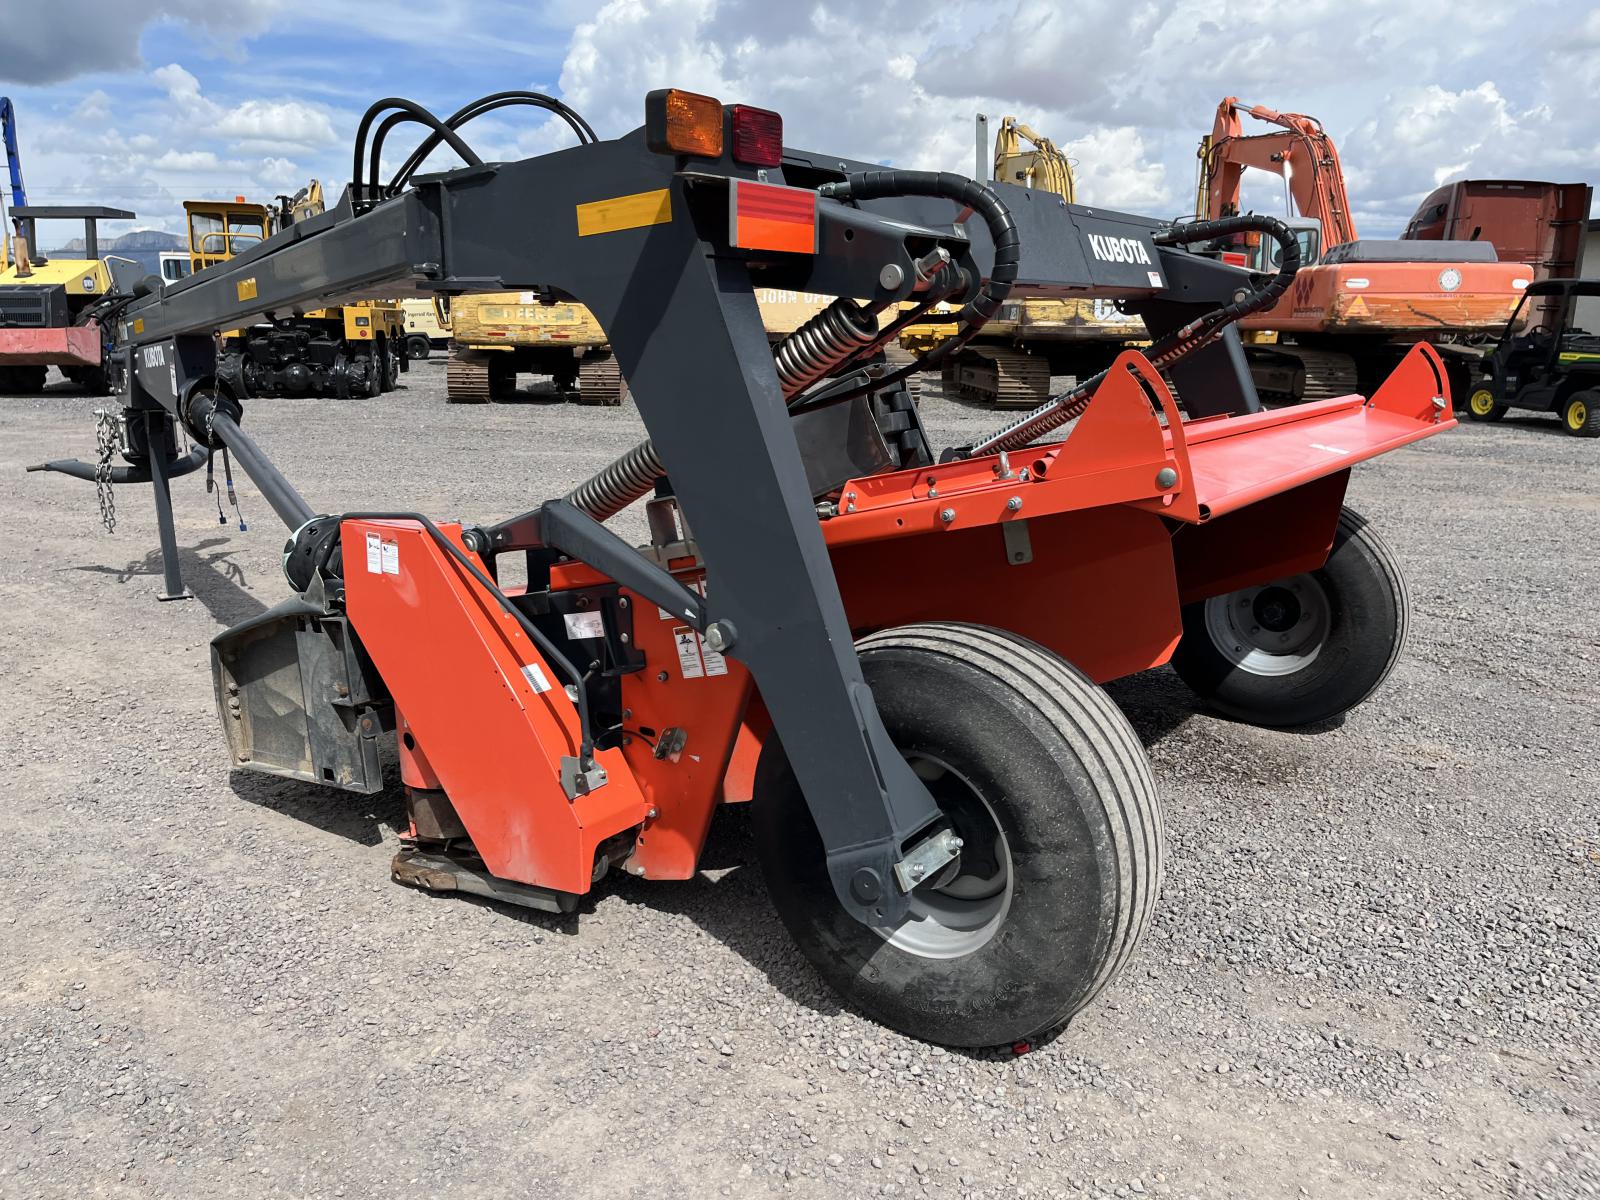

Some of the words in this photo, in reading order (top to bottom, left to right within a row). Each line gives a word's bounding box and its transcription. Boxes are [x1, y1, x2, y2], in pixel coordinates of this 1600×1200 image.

[1087, 233, 1152, 265] KUBOTA
[760, 289, 798, 304] JOHN
[143, 345, 165, 368] KUBOTA
